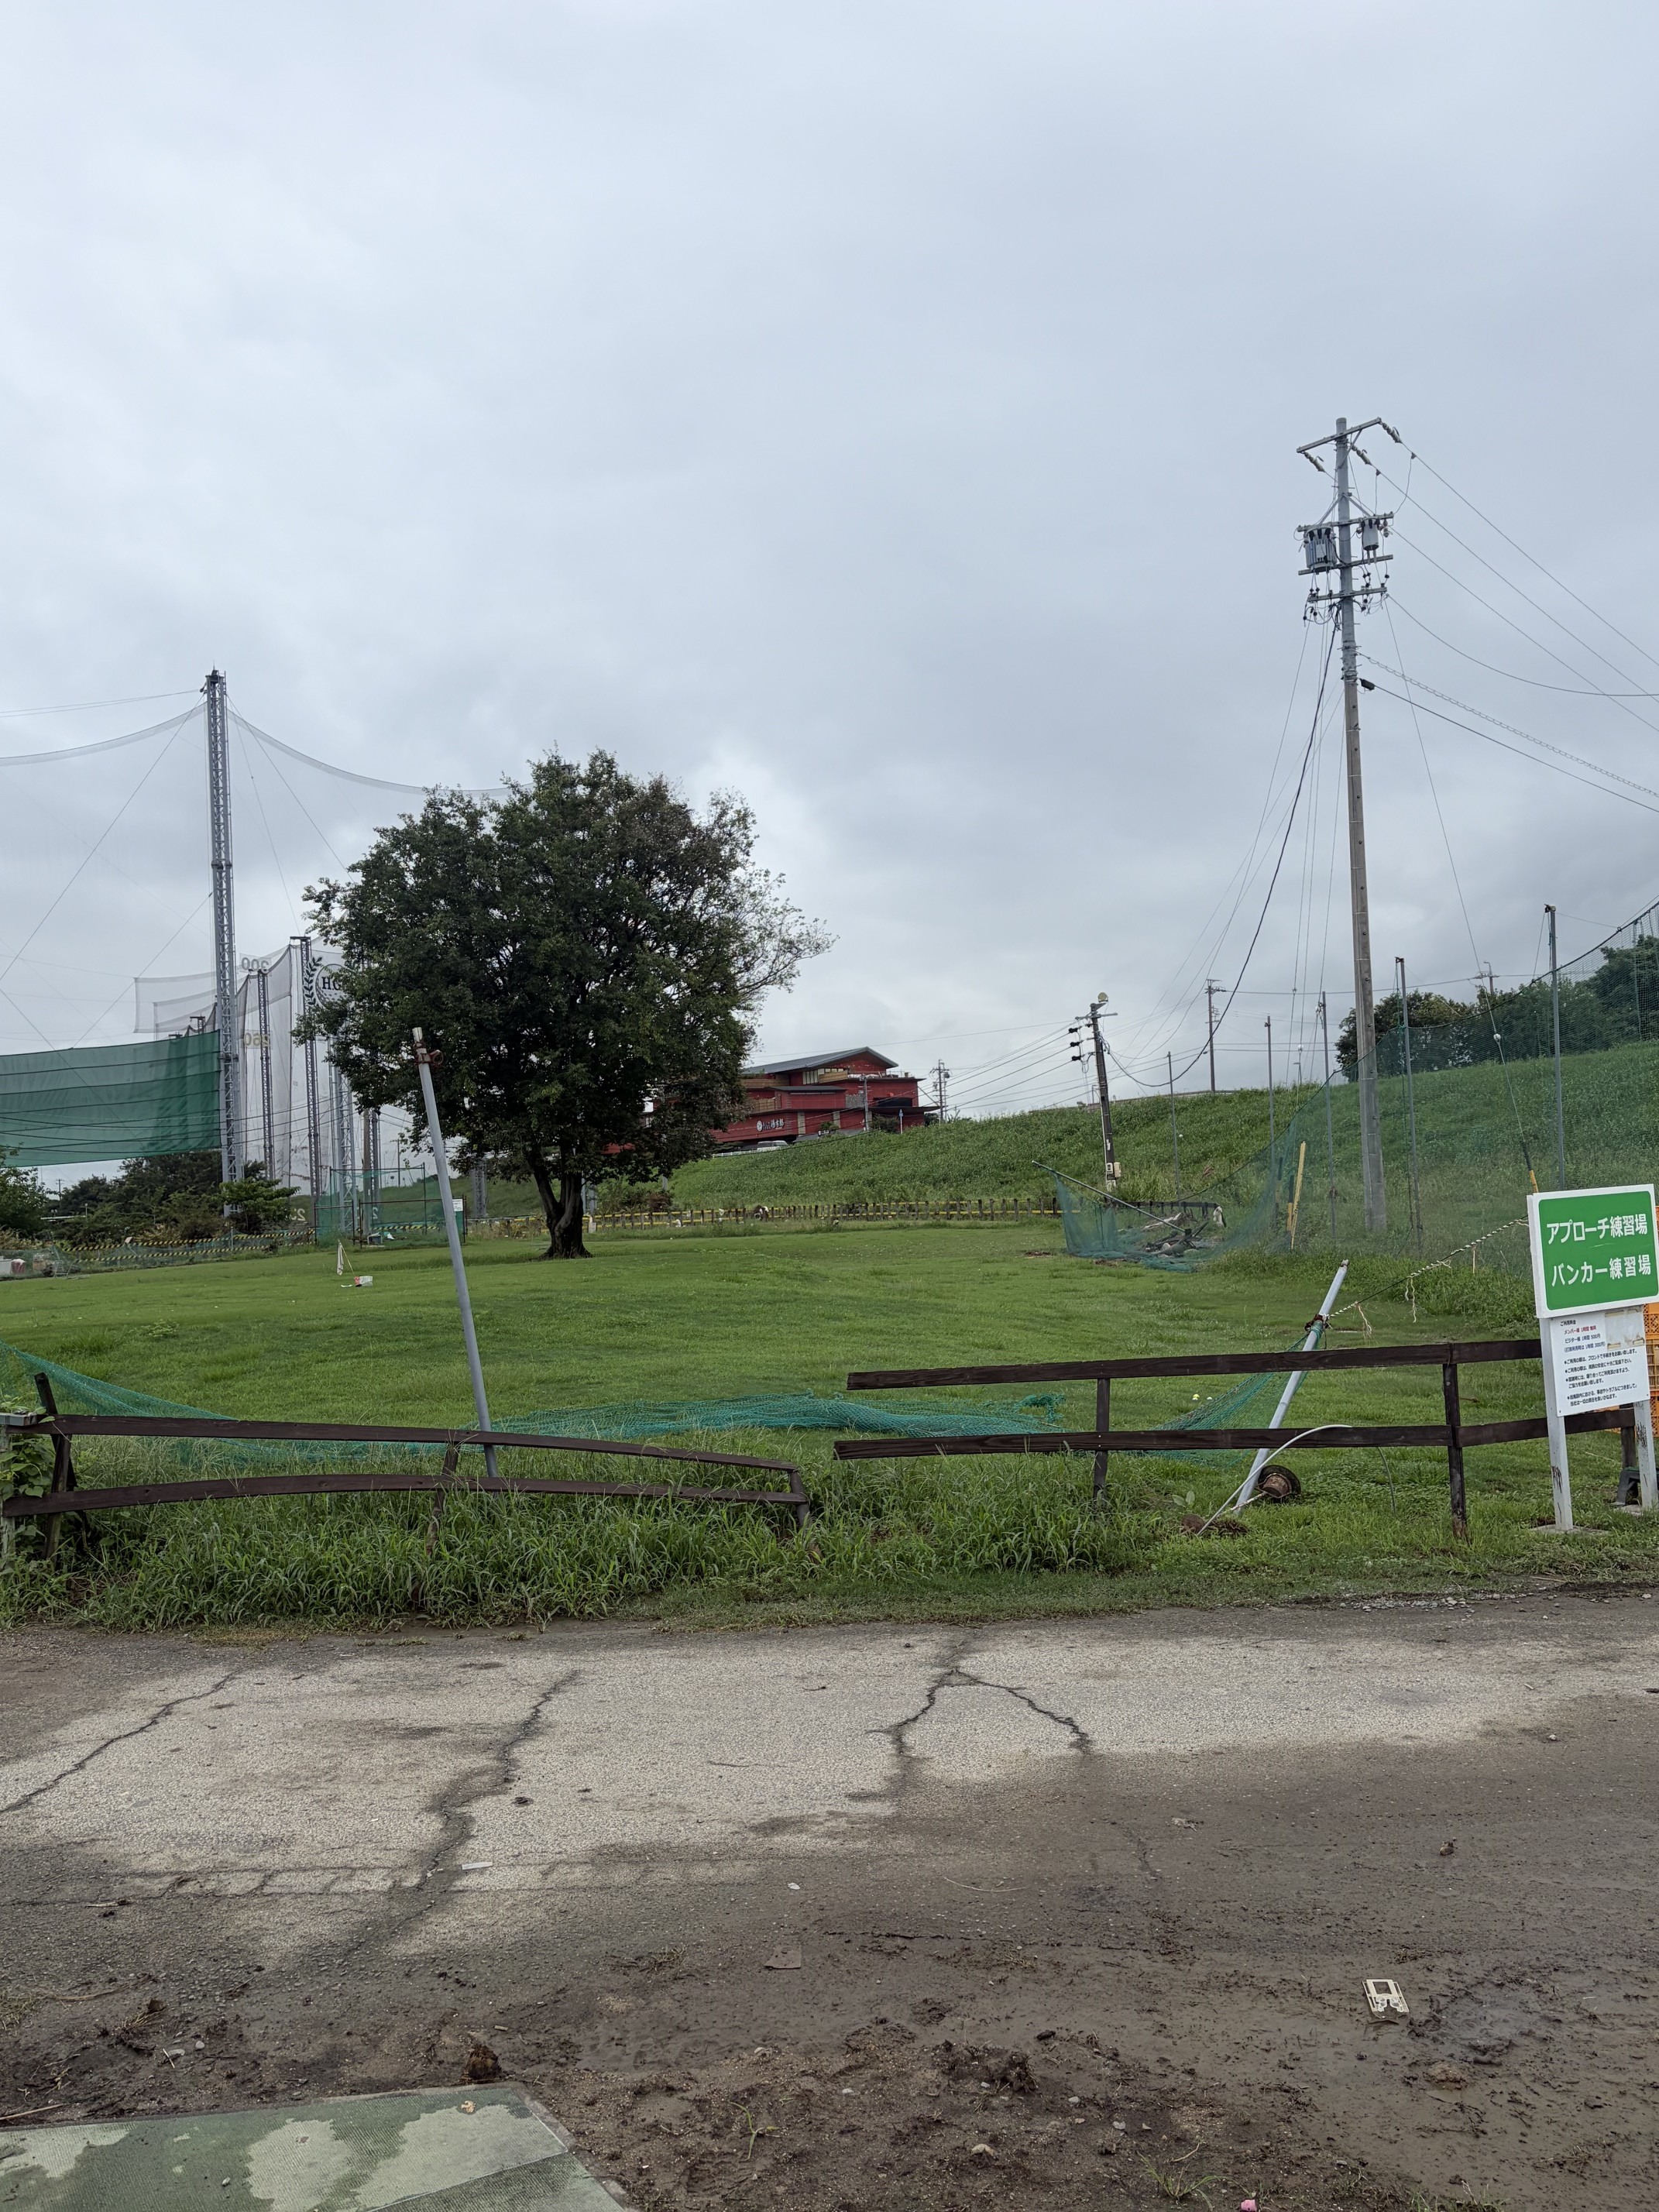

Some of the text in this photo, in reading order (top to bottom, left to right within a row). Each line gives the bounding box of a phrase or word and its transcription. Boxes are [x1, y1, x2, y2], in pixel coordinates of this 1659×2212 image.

[1546, 1213, 1648, 1245] アプローチ練習場
[1551, 1254, 1651, 1287] バンカー練習場
[1564, 1327, 1580, 1335] メンバー様
